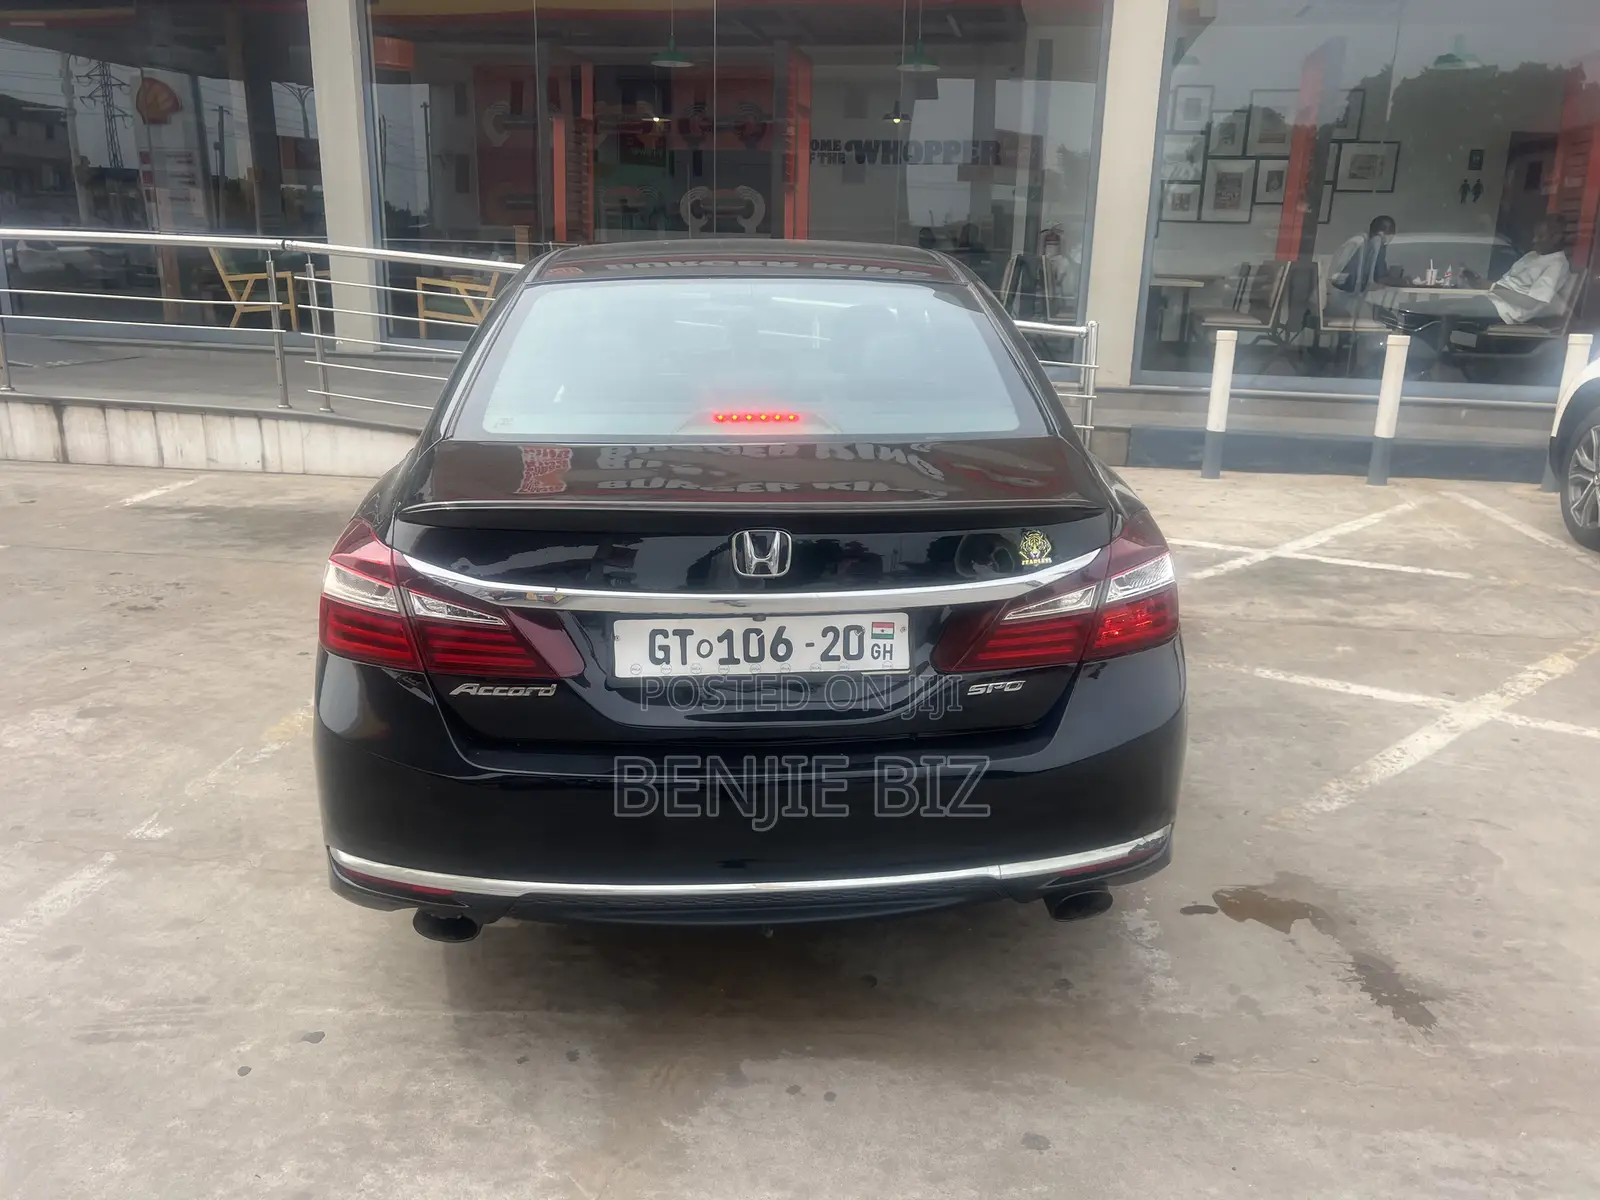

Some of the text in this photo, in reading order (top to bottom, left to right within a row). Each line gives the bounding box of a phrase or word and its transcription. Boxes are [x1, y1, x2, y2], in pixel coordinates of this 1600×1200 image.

[810, 138, 842, 151] OME
[844, 139, 1001, 165] WHOPPER
[817, 152, 846, 165] THE
[648, 628, 694, 666] GT
[716, 625, 794, 666] 106
[870, 643, 894, 661] GH
[448, 682, 558, 697] Accord
[966, 680, 1027, 696] SPO
